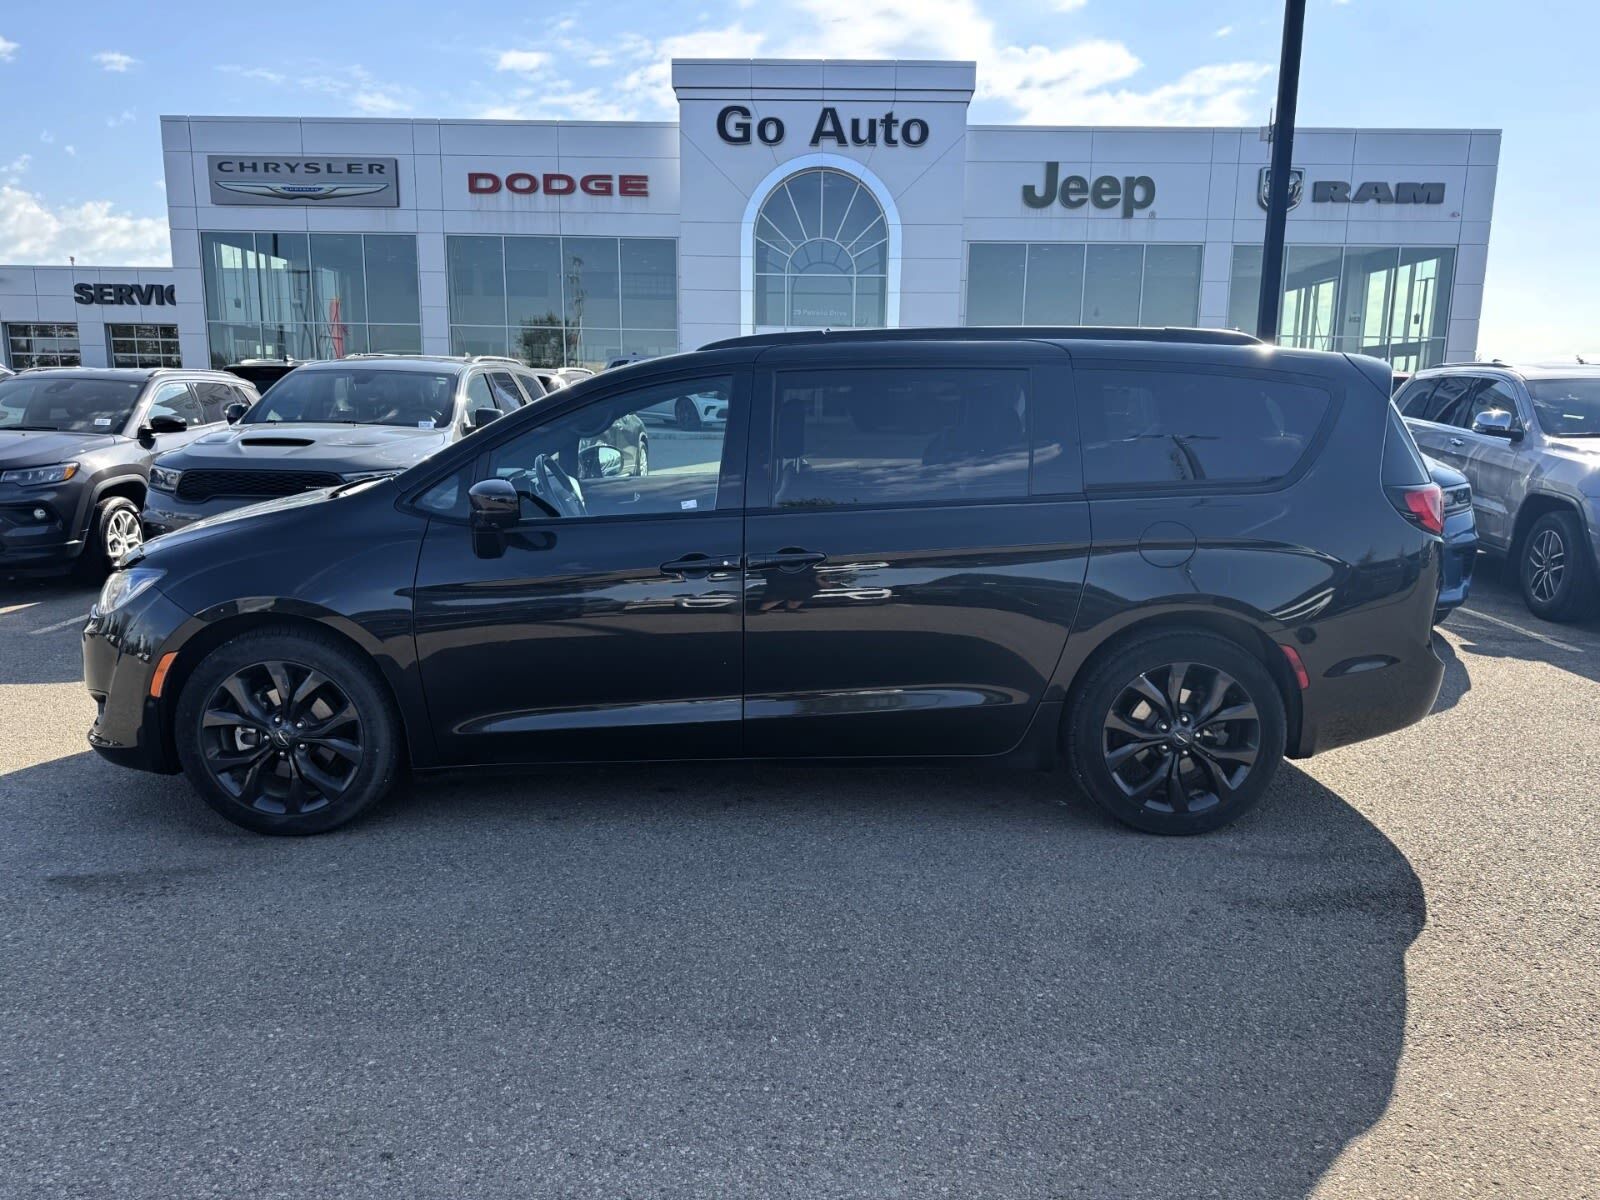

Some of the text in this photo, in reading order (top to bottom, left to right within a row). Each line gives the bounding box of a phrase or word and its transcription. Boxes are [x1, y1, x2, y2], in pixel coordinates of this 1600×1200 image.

[716, 105, 930, 147] Go Auto
[217, 161, 385, 175] CHRYSLER
[468, 172, 649, 197] DODGE
[1022, 161, 1156, 219] Jeep
[1312, 181, 1446, 204] RAM
